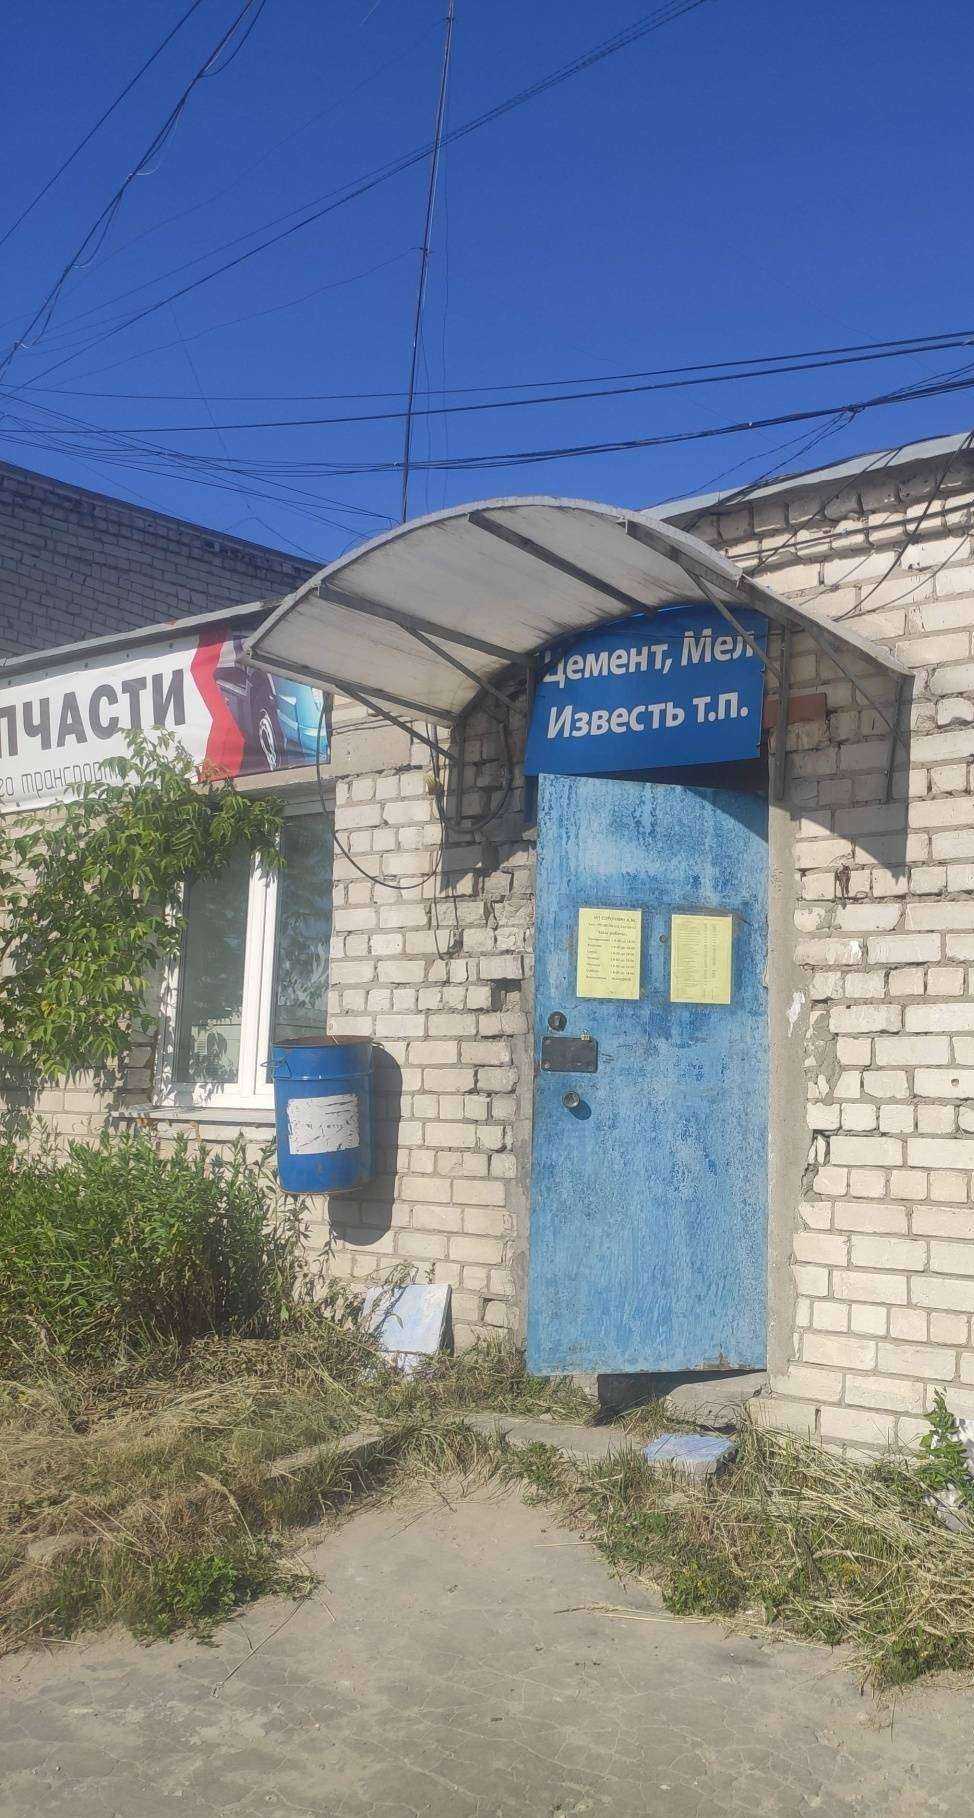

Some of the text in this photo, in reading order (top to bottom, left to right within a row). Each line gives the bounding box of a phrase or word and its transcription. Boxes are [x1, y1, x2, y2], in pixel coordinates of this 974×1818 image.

[680, 628, 755, 666] Мел
[0, 669, 186, 759] ПЧАСТИ
[547, 692, 749, 739] Известь т.п.
